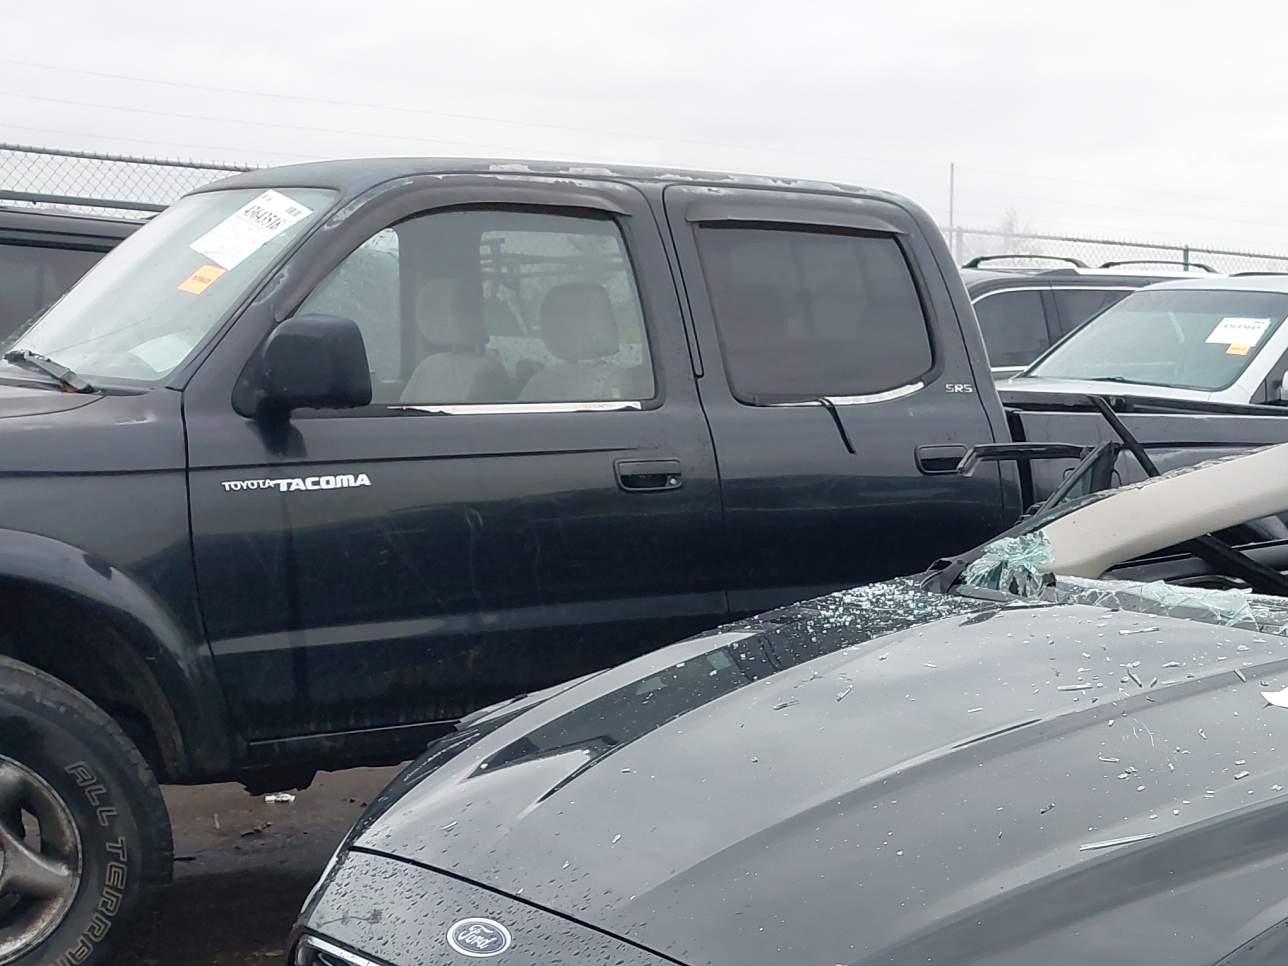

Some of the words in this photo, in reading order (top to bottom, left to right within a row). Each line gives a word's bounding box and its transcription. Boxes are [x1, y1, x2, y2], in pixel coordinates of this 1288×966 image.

[221, 480, 273, 491] TOYOTA
[273, 473, 371, 492] TACOMA
[65, 761, 118, 827] ALL
[458, 924, 497, 949] Ford
